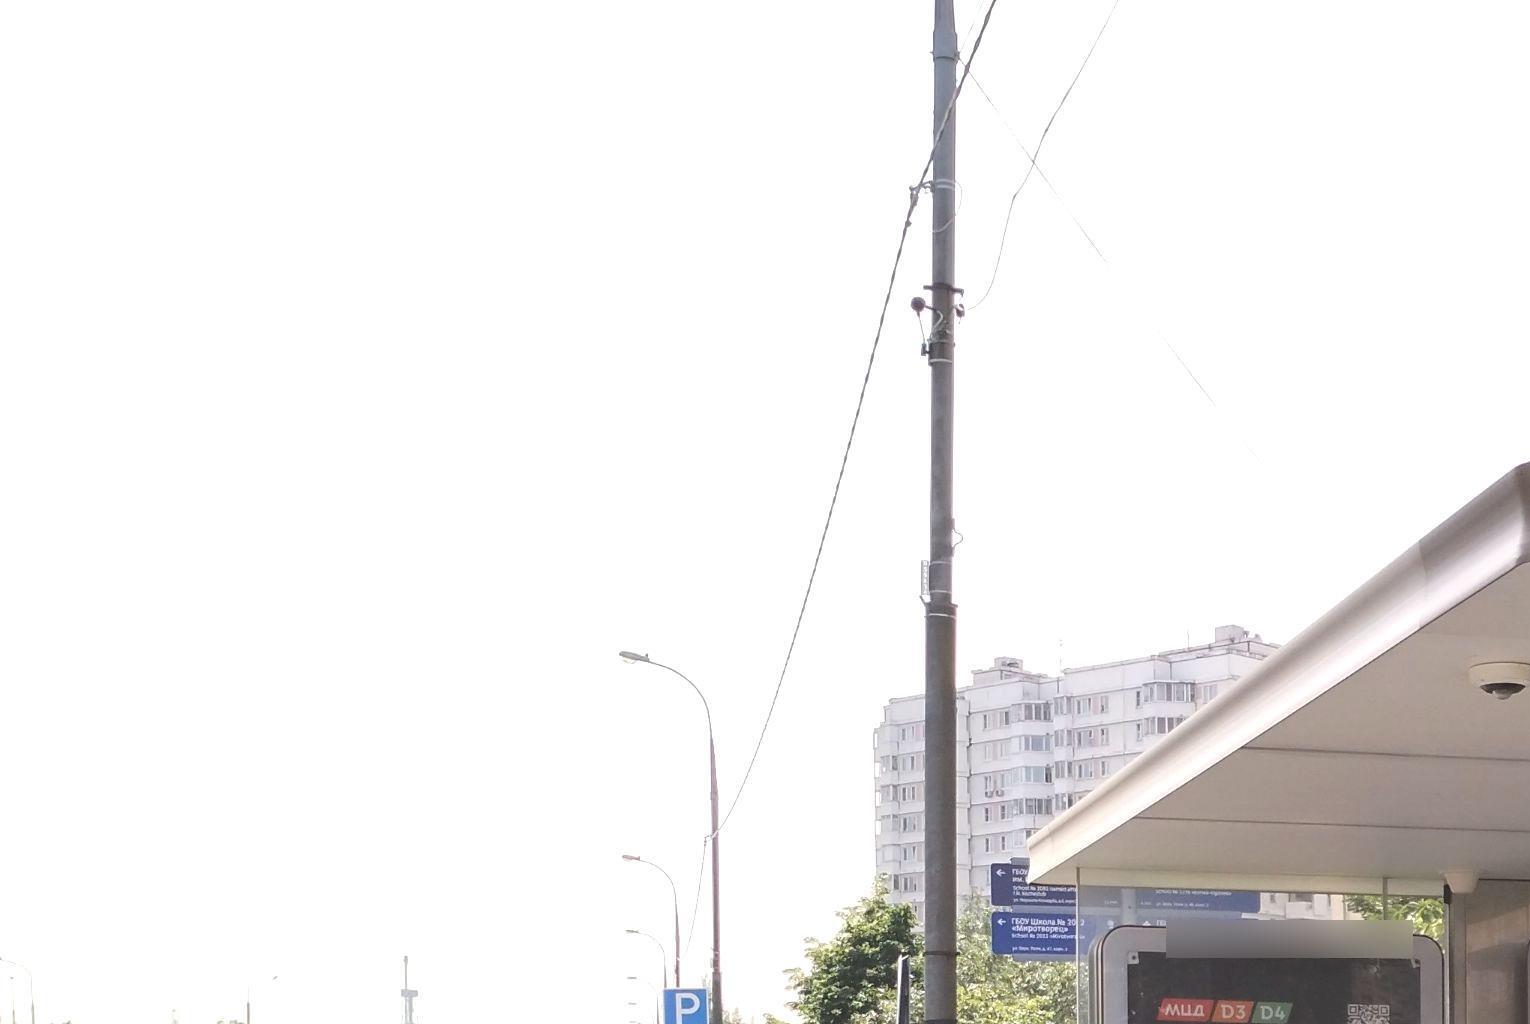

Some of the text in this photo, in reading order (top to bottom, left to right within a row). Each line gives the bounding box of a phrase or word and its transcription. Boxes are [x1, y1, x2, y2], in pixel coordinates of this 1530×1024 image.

[1011, 917, 1030, 925] ГБОУ
[1030, 918, 1056, 926] Школа
[1163, 1003, 1205, 1018] МЦД
[1220, 1004, 1246, 1020] D3
[1260, 1004, 1286, 1020] D4
